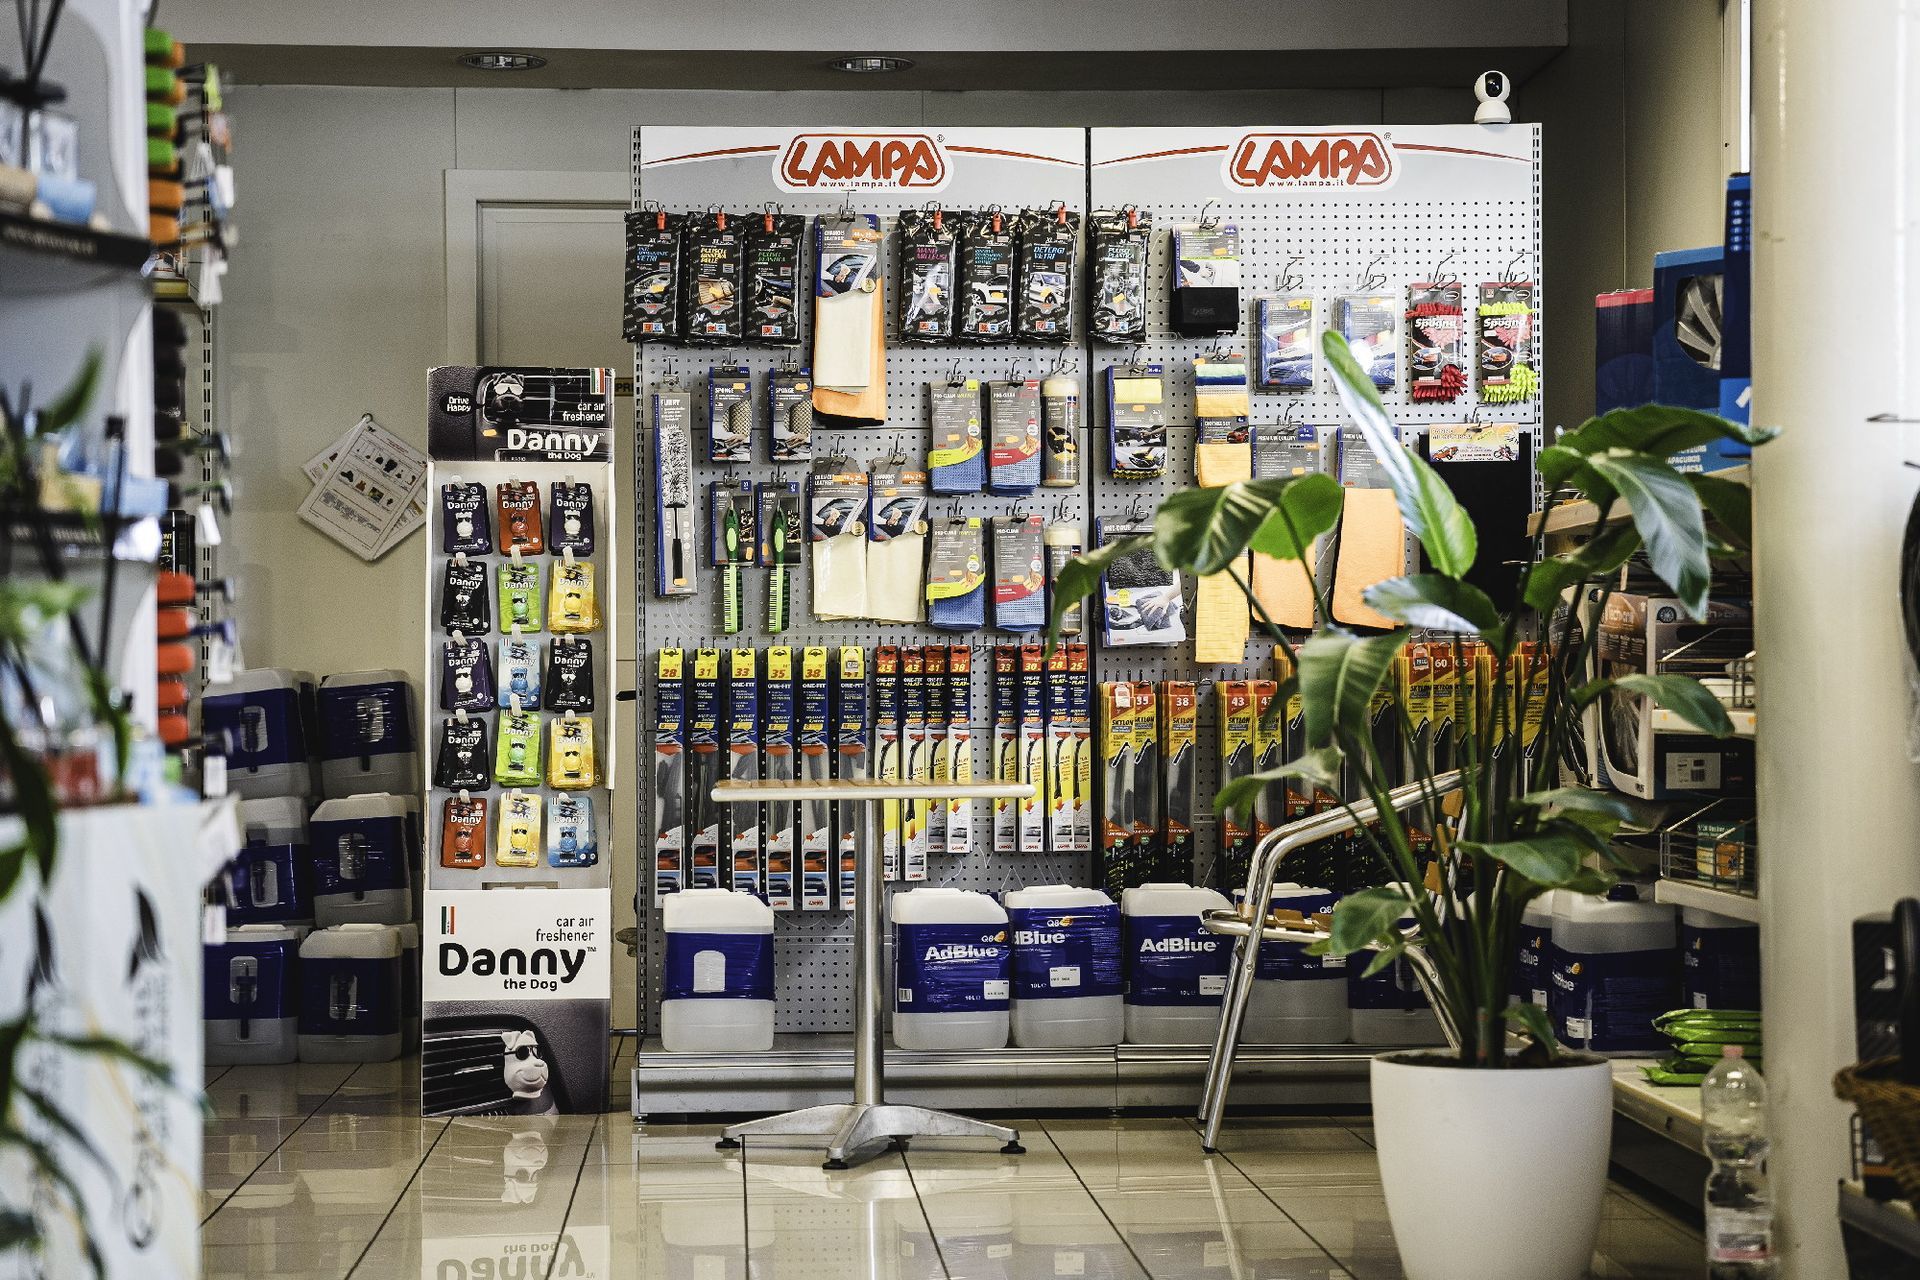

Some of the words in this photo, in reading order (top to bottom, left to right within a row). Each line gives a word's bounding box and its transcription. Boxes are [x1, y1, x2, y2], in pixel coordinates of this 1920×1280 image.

[787, 140, 939, 186] LAMPA
[1237, 140, 1386, 186] LAMPA
[820, 180, 897, 189] www.lampa.it
[1268, 179, 1344, 188] www.lampa.it
[1483, 318, 1526, 329] Spugna
[448, 397, 470, 405] Drive
[447, 404, 472, 413] Happy
[577, 403, 593, 411] car
[562, 411, 606, 422] freshener
[508, 429, 599, 456] Danny
[953, 663, 966, 672] 38
[1070, 662, 1084, 670] 25
[1434, 658, 1448, 668] 60
[698, 668, 711, 677] 31
[735, 668, 749, 677] 33
[878, 664, 893, 673] 45
[904, 664, 919, 672] 43
[927, 664, 941, 672] 41
[661, 668, 677, 678] 28
[771, 669, 786, 678] 35
[805, 669, 821, 678] 38
[1136, 695, 1149, 705] 35
[1176, 697, 1189, 706] 38
[1231, 696, 1245, 706] 43
[556, 917, 575, 927] car
[578, 917, 594, 927] air
[1046, 919, 1060, 927] Q8
[536, 928, 594, 942] freshener
[981, 935, 994, 943] Q8
[1140, 937, 1217, 952] AdBlue
[924, 944, 999, 960] AdBlue
[439, 942, 587, 984] Danny
[504, 978, 527, 990] the
[530, 979, 558, 991] Dog
